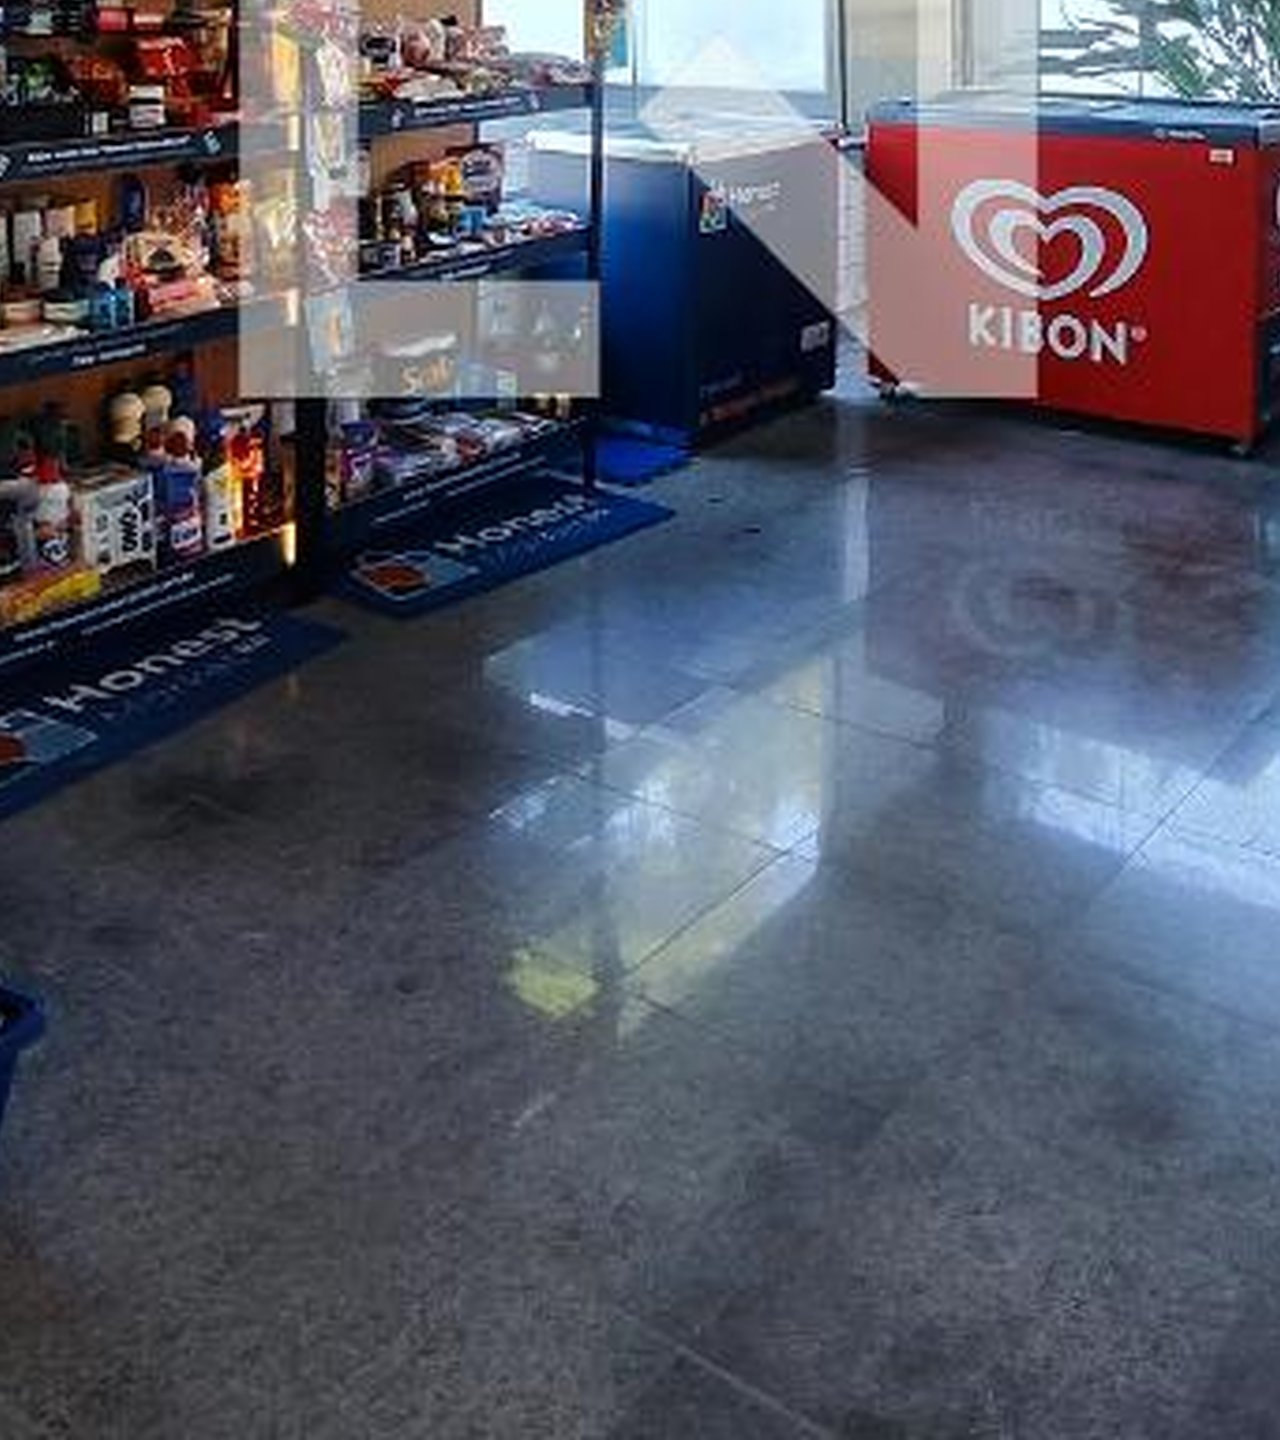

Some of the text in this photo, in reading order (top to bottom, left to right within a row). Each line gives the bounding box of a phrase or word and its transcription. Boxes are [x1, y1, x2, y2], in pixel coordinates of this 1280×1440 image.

[969, 302, 1127, 366] KIBON
[433, 494, 586, 556] Honest
[42, 617, 263, 713] Honest
